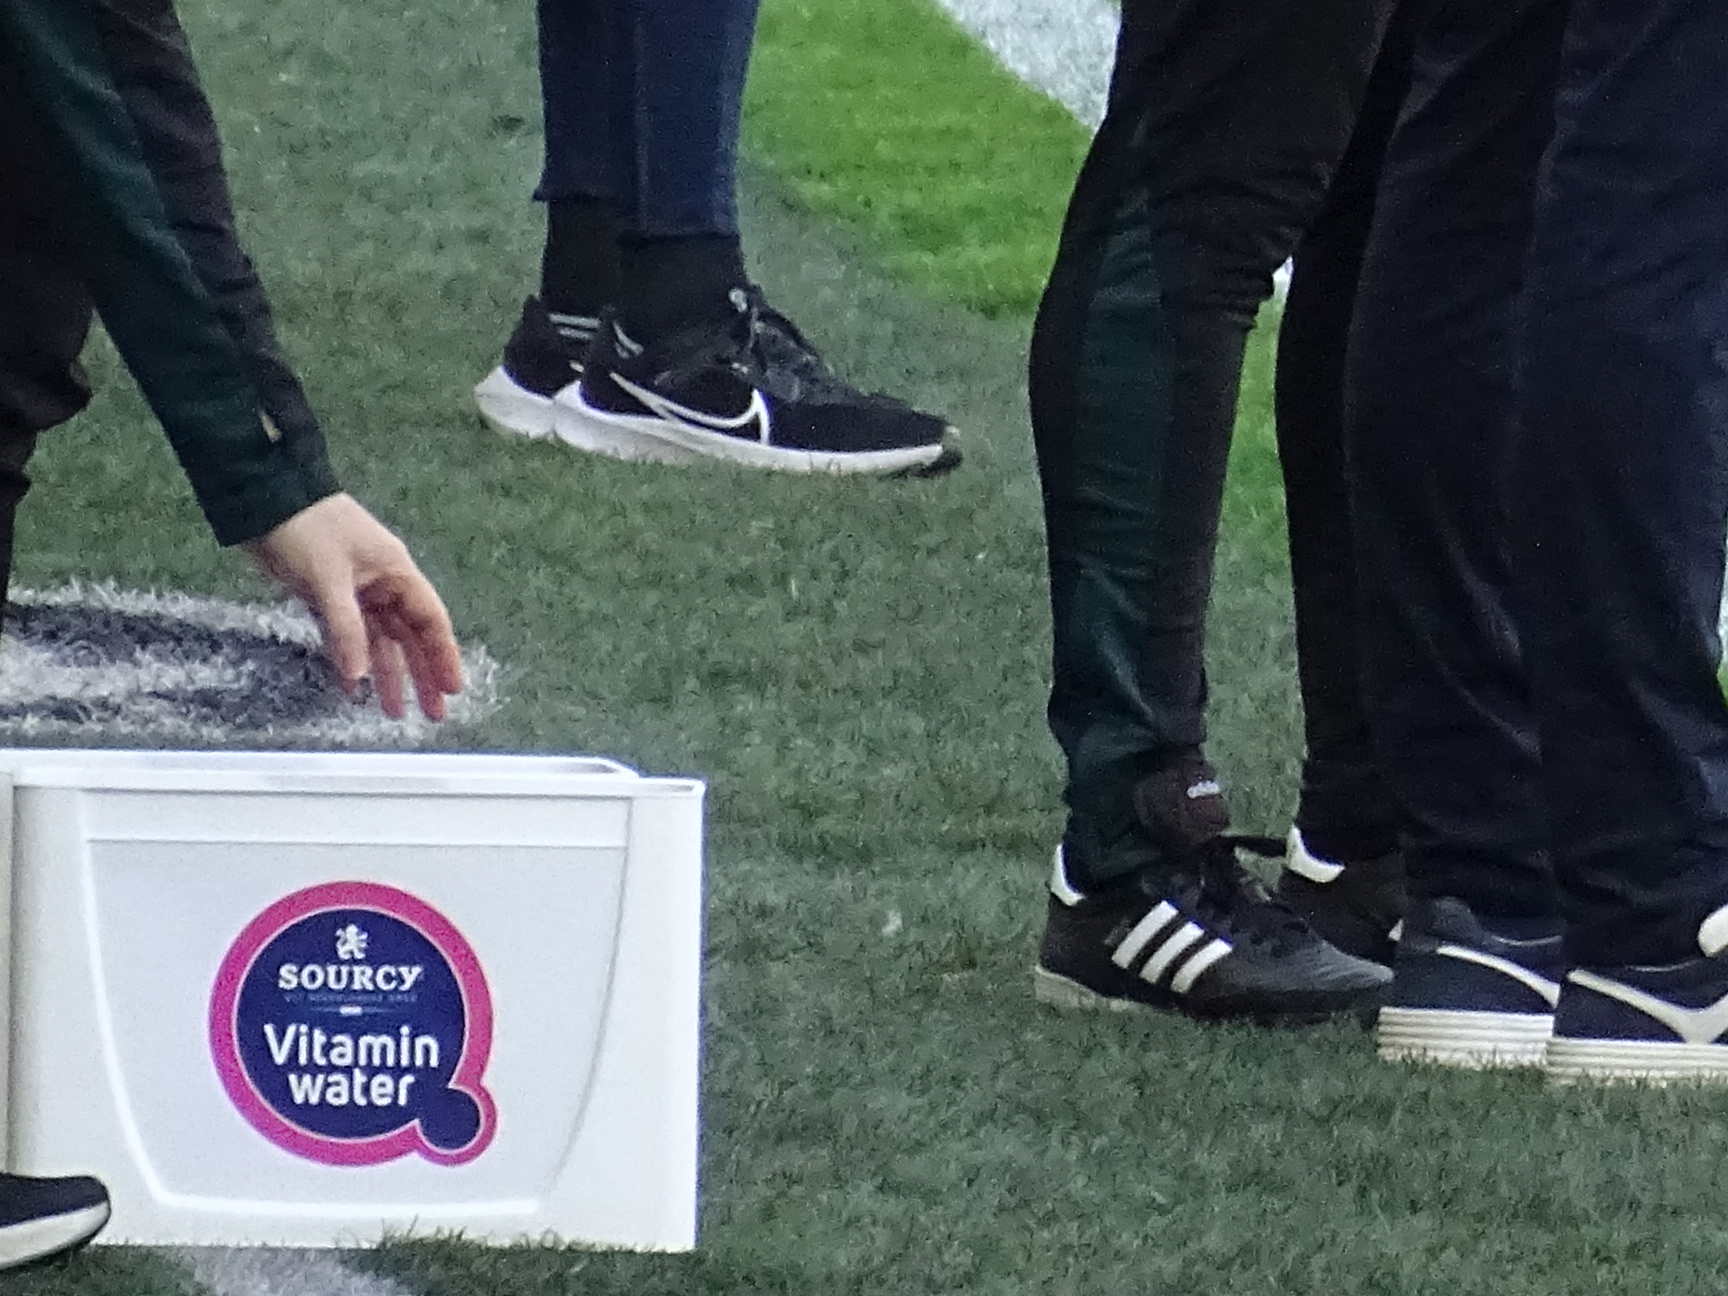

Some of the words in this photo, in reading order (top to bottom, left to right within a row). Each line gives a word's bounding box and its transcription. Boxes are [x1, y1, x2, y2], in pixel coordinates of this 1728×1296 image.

[277, 963, 423, 991] SOURCY
[263, 1022, 440, 1068] Vitamin
[287, 1067, 416, 1107] water
